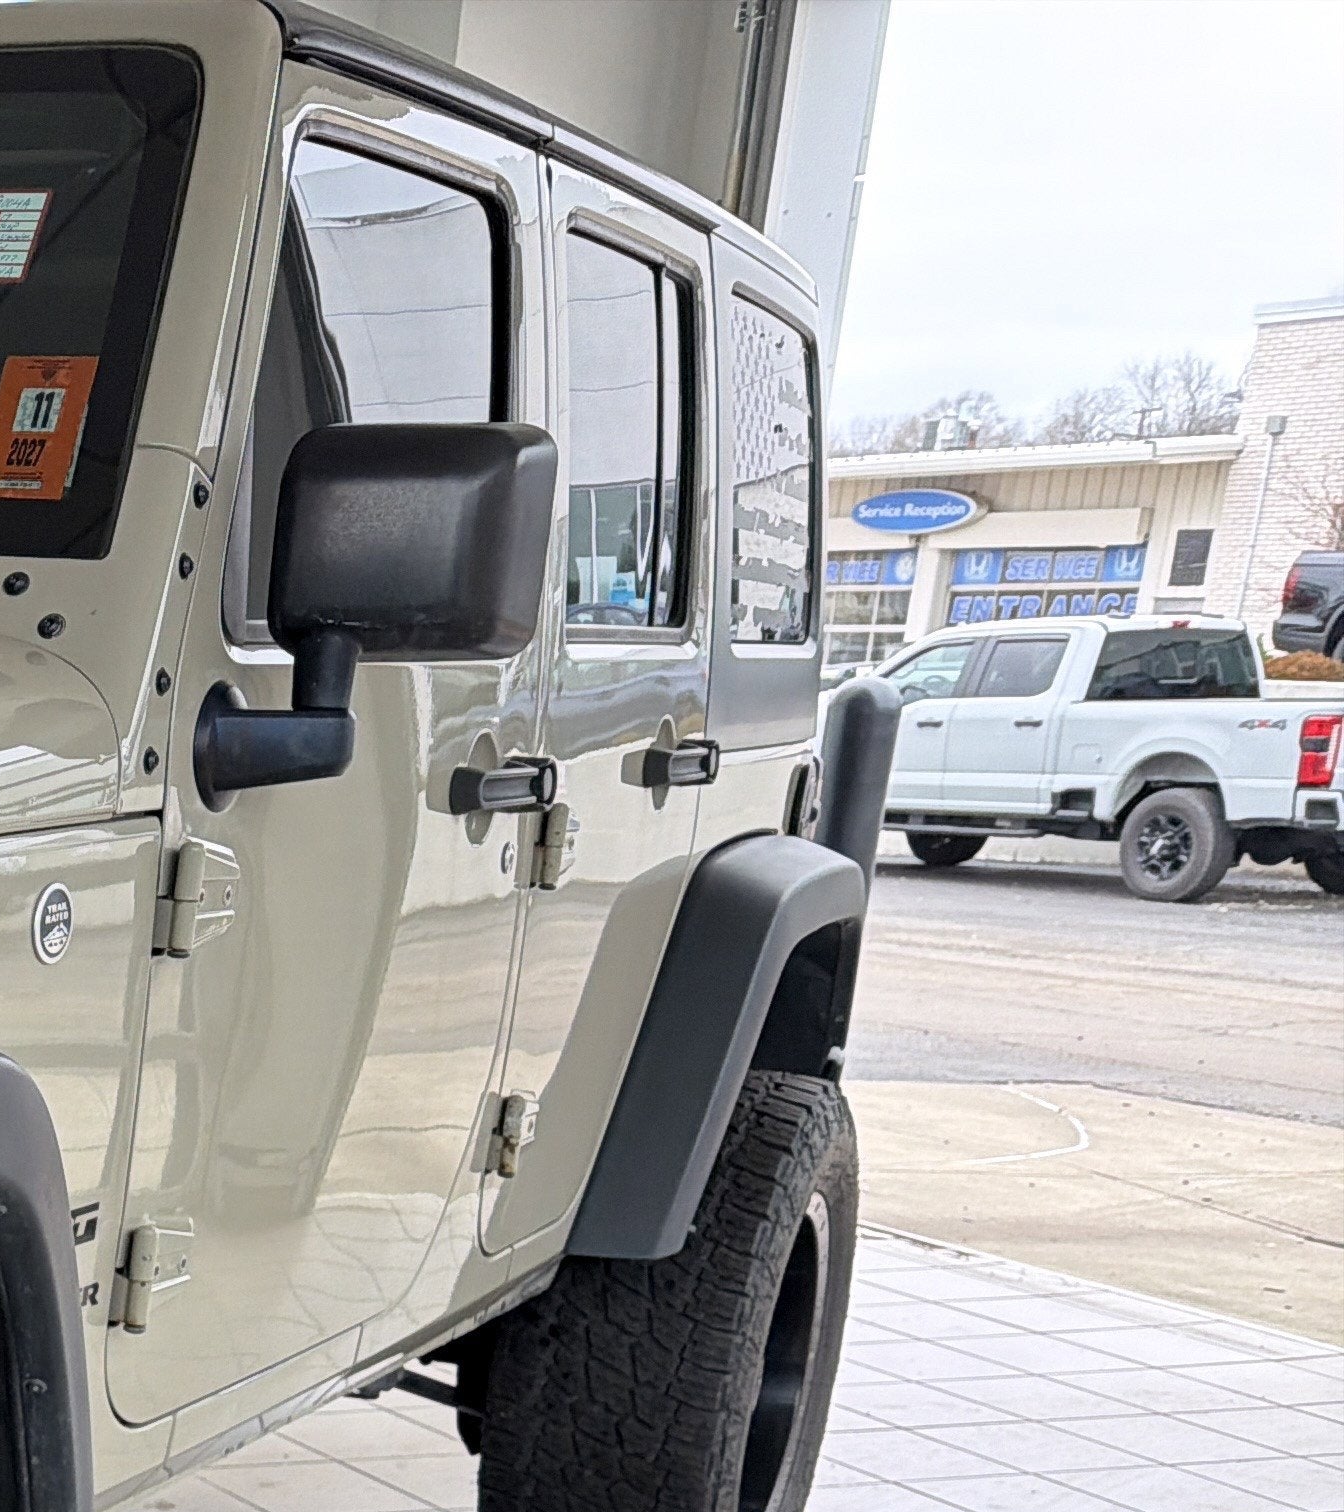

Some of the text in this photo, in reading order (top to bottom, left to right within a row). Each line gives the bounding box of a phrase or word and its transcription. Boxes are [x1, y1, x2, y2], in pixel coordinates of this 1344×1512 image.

[30, 391, 56, 429] 11
[6, 437, 47, 467] 2027
[858, 502, 967, 519] Service Reception
[47, 901, 68, 914] TRAIL
[45, 911, 69, 925] RATED
